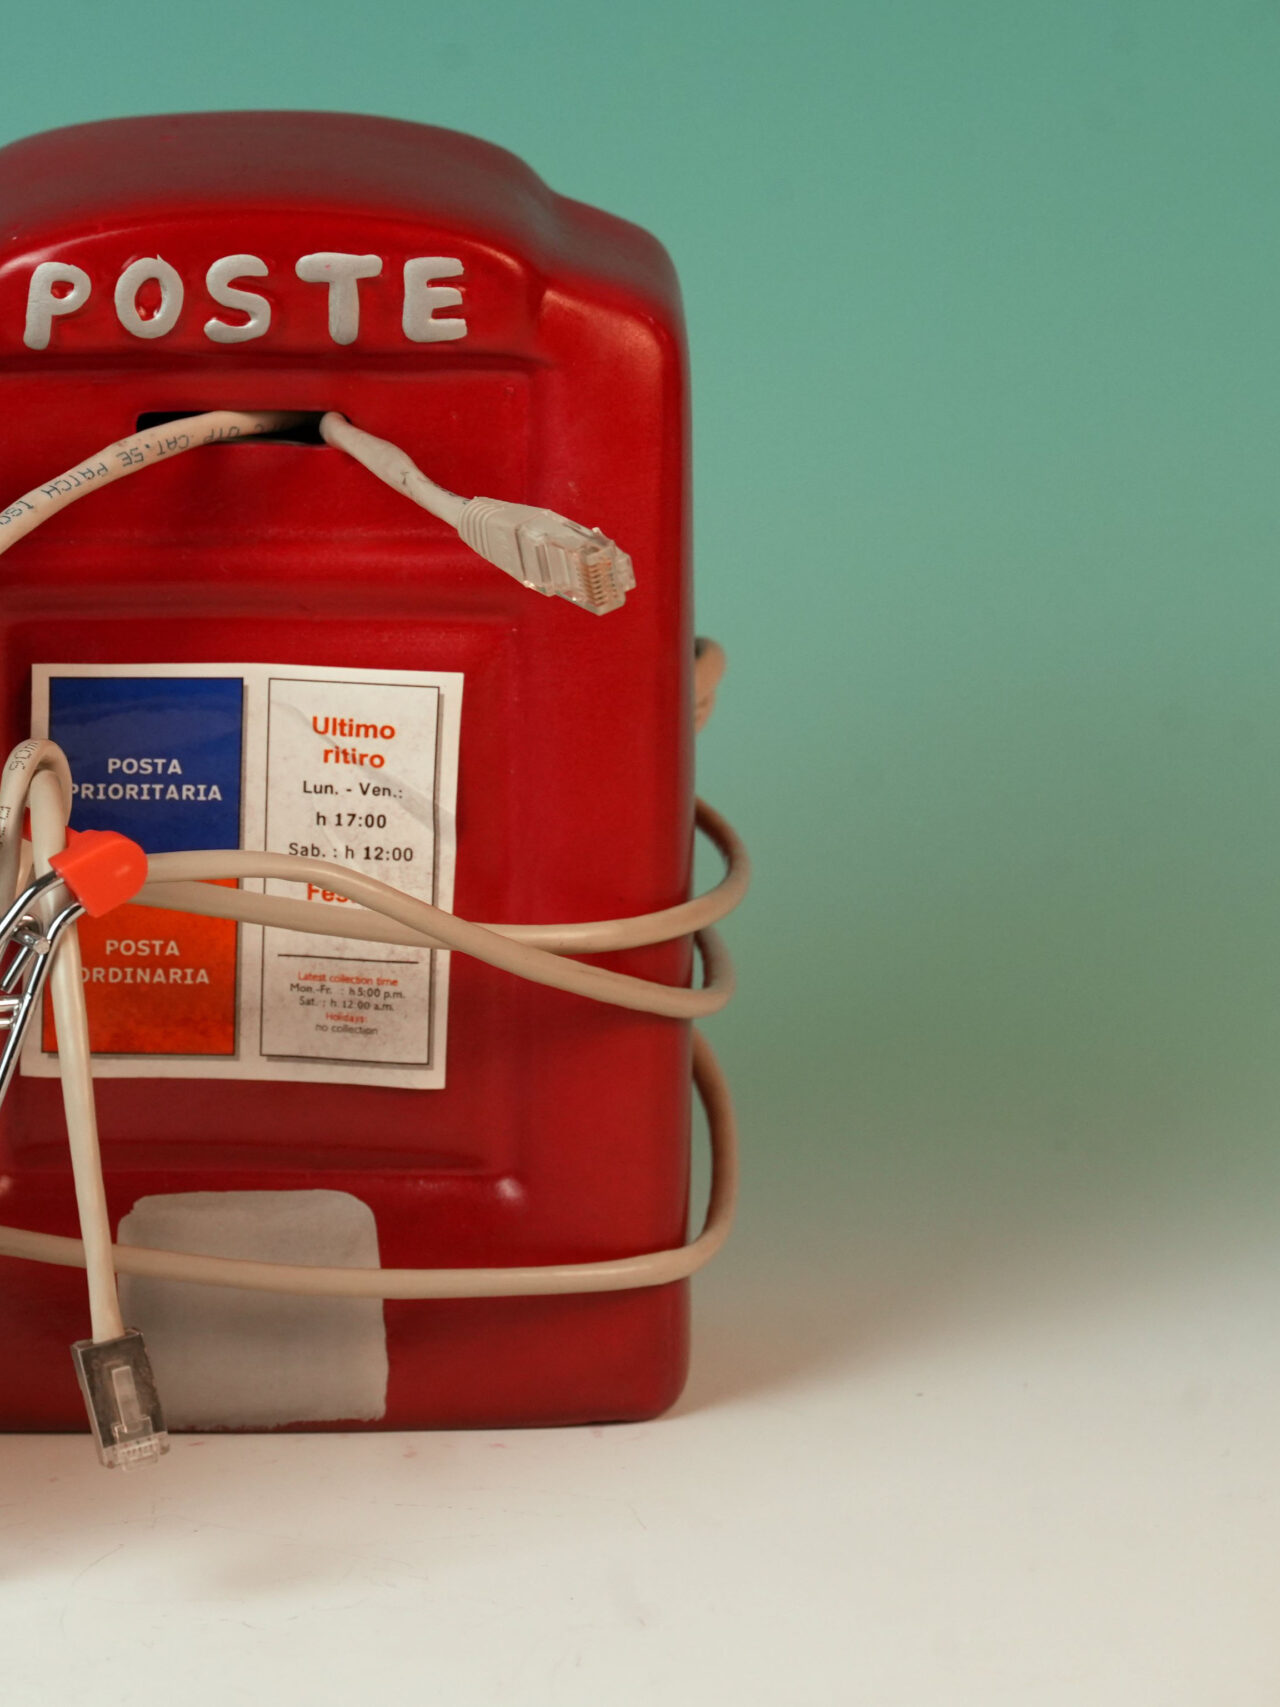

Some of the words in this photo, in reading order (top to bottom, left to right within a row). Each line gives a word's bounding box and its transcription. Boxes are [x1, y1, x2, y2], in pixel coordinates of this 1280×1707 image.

[23, 252, 467, 350] POSTE
[41, 462, 109, 498] PATCH
[312, 715, 396, 740] Ultimo
[323, 745, 385, 769] ritiro
[107, 758, 183, 775] POSTA
[71, 783, 223, 801] PRIORITARIA
[303, 780, 339, 796] Lun.
[359, 782, 403, 799] Ven.:
[316, 811, 327, 827] h
[335, 812, 388, 829] 17:00
[288, 842, 326, 859] Sab.
[345, 845, 355, 860] h
[363, 846, 414, 862] 12:00
[105, 939, 181, 957] POSTA
[80, 967, 210, 985] ORDINARIA
[298, 971, 326, 982] Latest
[329, 974, 374, 985] collection
[376, 977, 399, 987] time
[383, 990, 406, 1001] p.m.
[373, 1001, 394, 1012] a.m.
[315, 1023, 329, 1033] no
[331, 1024, 378, 1036] collection
